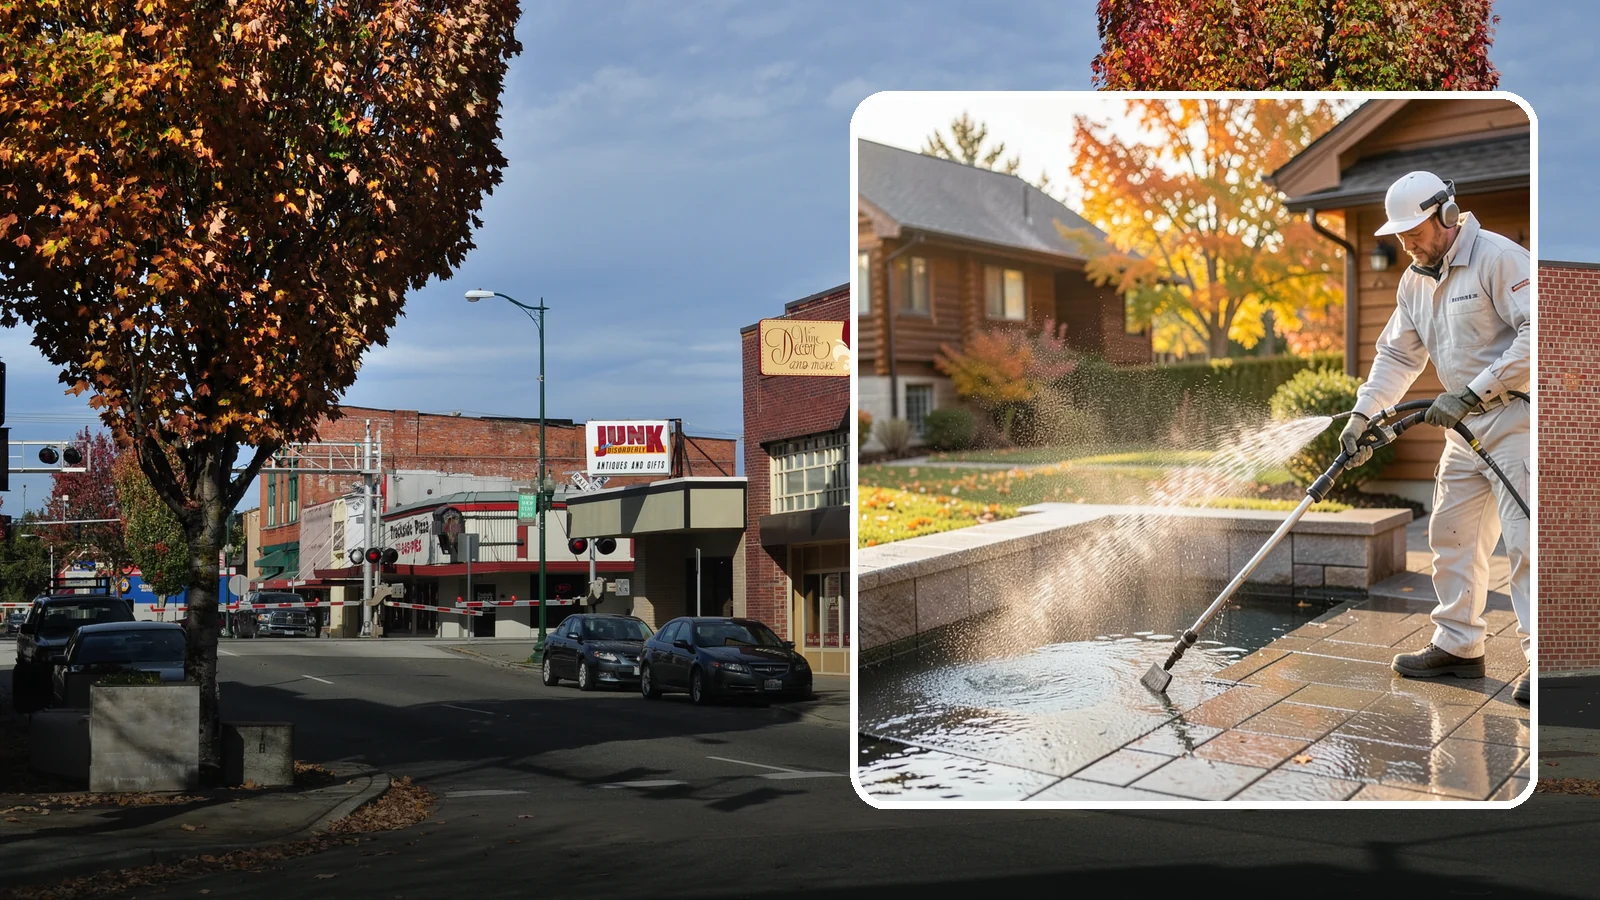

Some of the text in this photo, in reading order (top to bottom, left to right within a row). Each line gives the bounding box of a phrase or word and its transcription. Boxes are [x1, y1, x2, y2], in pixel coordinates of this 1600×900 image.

[595, 425, 665, 457] JUNK
[607, 446, 646, 454] DISORDERLY
[596, 460, 666, 470] ANTIQUES AND GIFTS
[414, 519, 429, 535] Pizza
